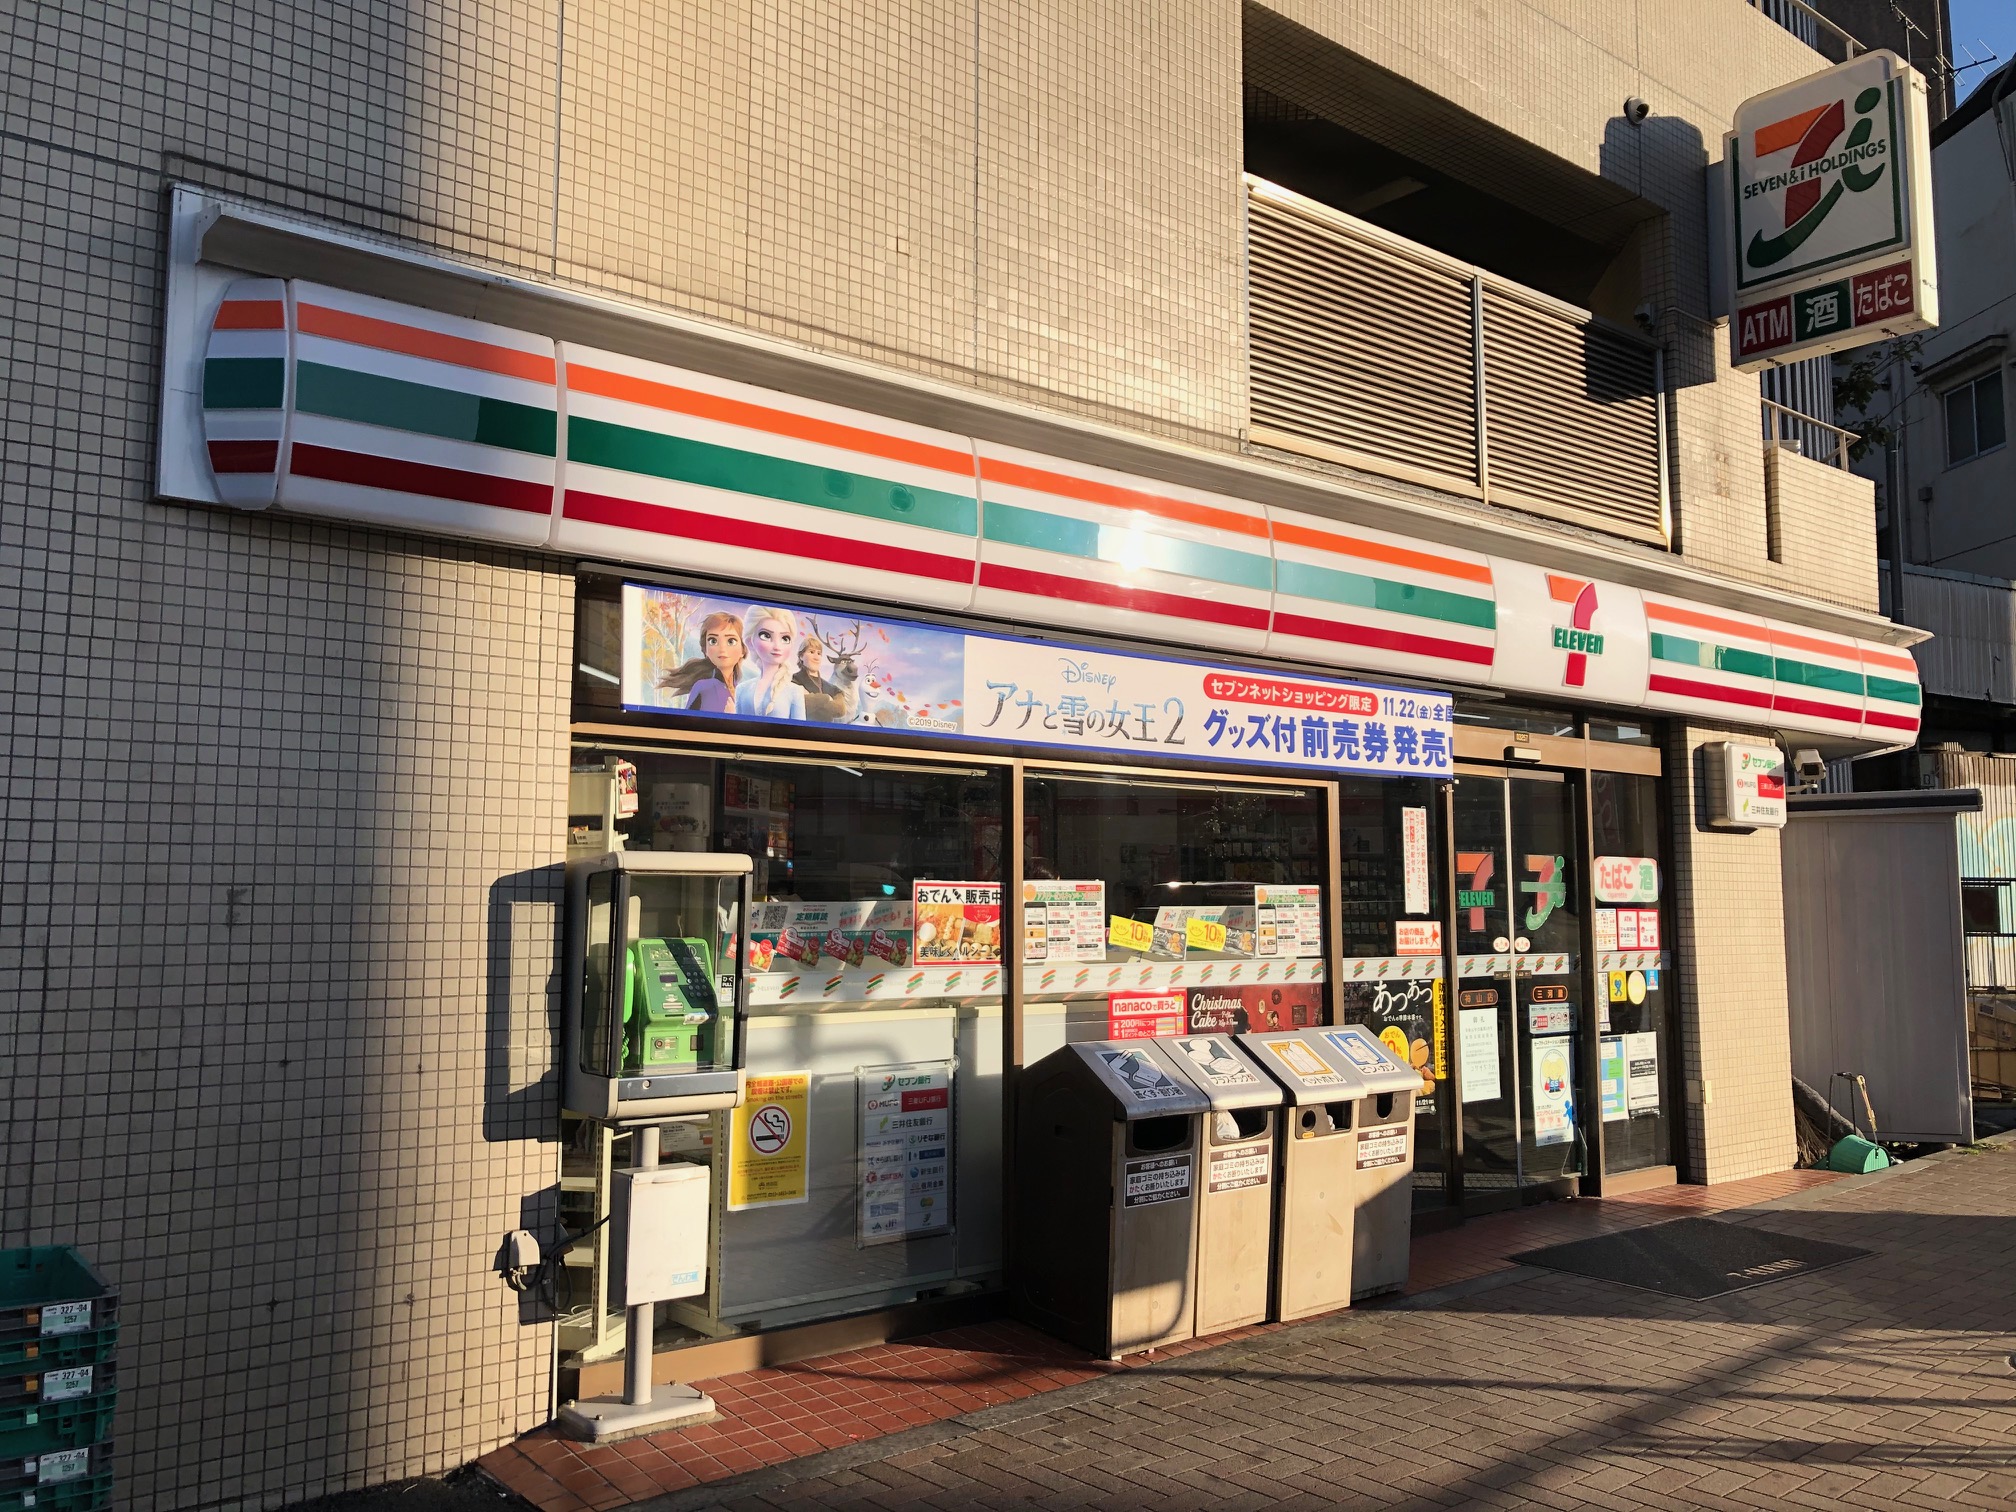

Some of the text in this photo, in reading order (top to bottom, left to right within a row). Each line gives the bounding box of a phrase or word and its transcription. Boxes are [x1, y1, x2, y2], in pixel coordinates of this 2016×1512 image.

[1809, 139, 1887, 176] HOLDINGS
[1855, 273, 1911, 317] たばこ
[1805, 290, 1839, 333] 酒
[1742, 304, 1789, 348] ATM
[1210, 677, 1374, 715] セブンネットショッピング限定
[979, 678, 1187, 747] アナと雪の女王2
[907, 716, 957, 731] ©2019 Disney
[1203, 707, 1454, 769] グッズ付前売券発売
[1600, 863, 1634, 890] たばこ
[1639, 864, 1654, 891] 酒
[917, 888, 1003, 905] おでん 販売中
[1114, 1000, 1176, 1012] nanacoで買うと
[1192, 993, 1242, 1011] Christmas
[1191, 1010, 1218, 1028] Cake
[898, 1075, 931, 1087] セブン銀行
[1302, 1074, 1344, 1085] ペットボトル
[878, 1099, 899, 1108] MUFG
[892, 1116, 934, 1129] 三井住友銀行
[917, 1133, 946, 1143] りそな銀行
[60, 1306, 74, 1315] 327
[62, 1372, 75, 1380] 327
